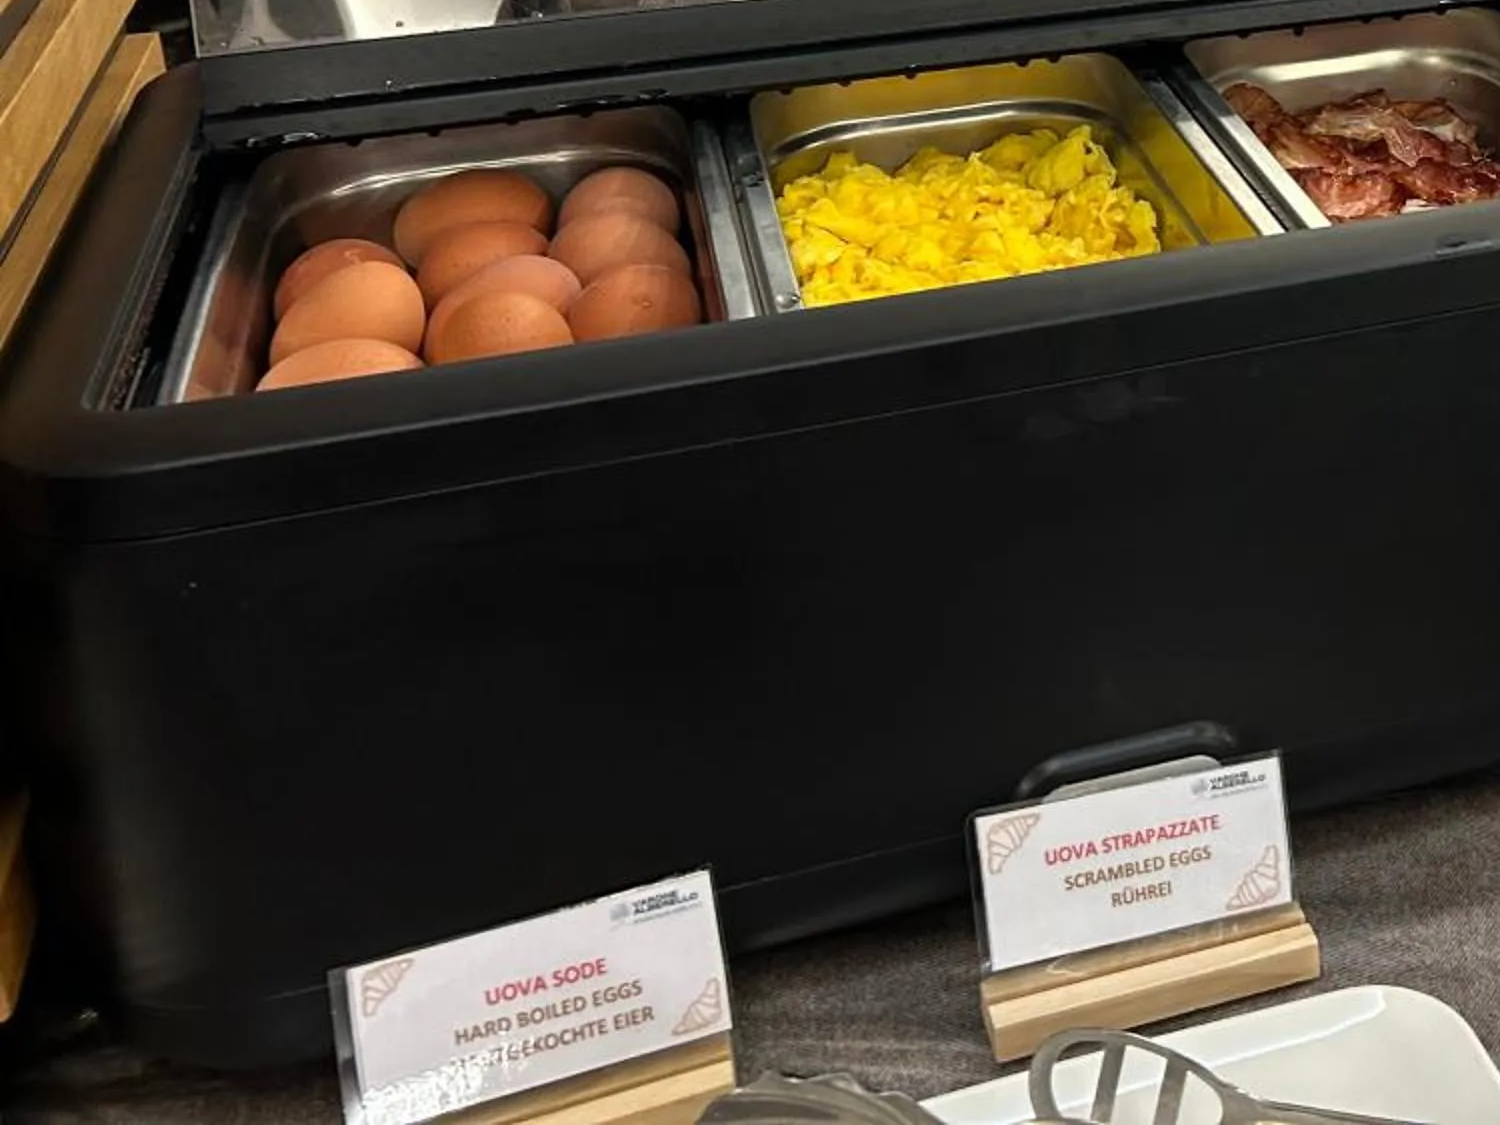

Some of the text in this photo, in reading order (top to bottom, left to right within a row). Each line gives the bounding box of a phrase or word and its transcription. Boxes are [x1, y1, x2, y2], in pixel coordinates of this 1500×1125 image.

[1044, 814, 1220, 865] UOVA STRAPAZZATE
[1064, 845, 1212, 891] SCRAMBLED EGGS
[1111, 881, 1172, 908] RÜHREI
[484, 958, 608, 1005] UOVA SODE
[455, 979, 643, 1045] HARD BOILED EGGS
[613, 1006, 655, 1031] EIER
